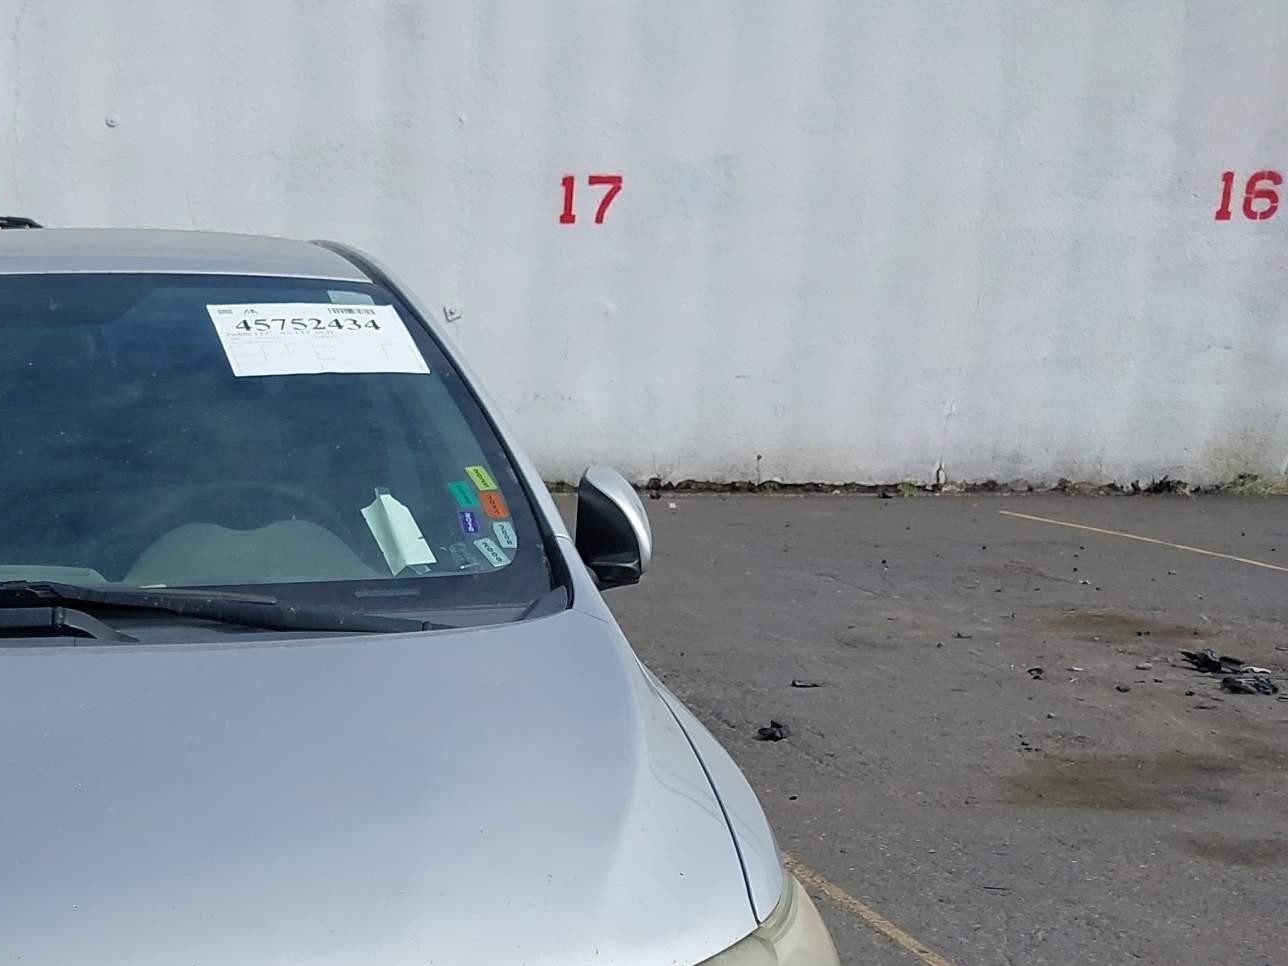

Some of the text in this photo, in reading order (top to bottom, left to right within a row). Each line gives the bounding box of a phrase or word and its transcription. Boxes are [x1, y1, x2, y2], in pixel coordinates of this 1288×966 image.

[558, 173, 623, 226] 17
[1214, 170, 1284, 222] 16
[235, 318, 382, 332] 45752434
